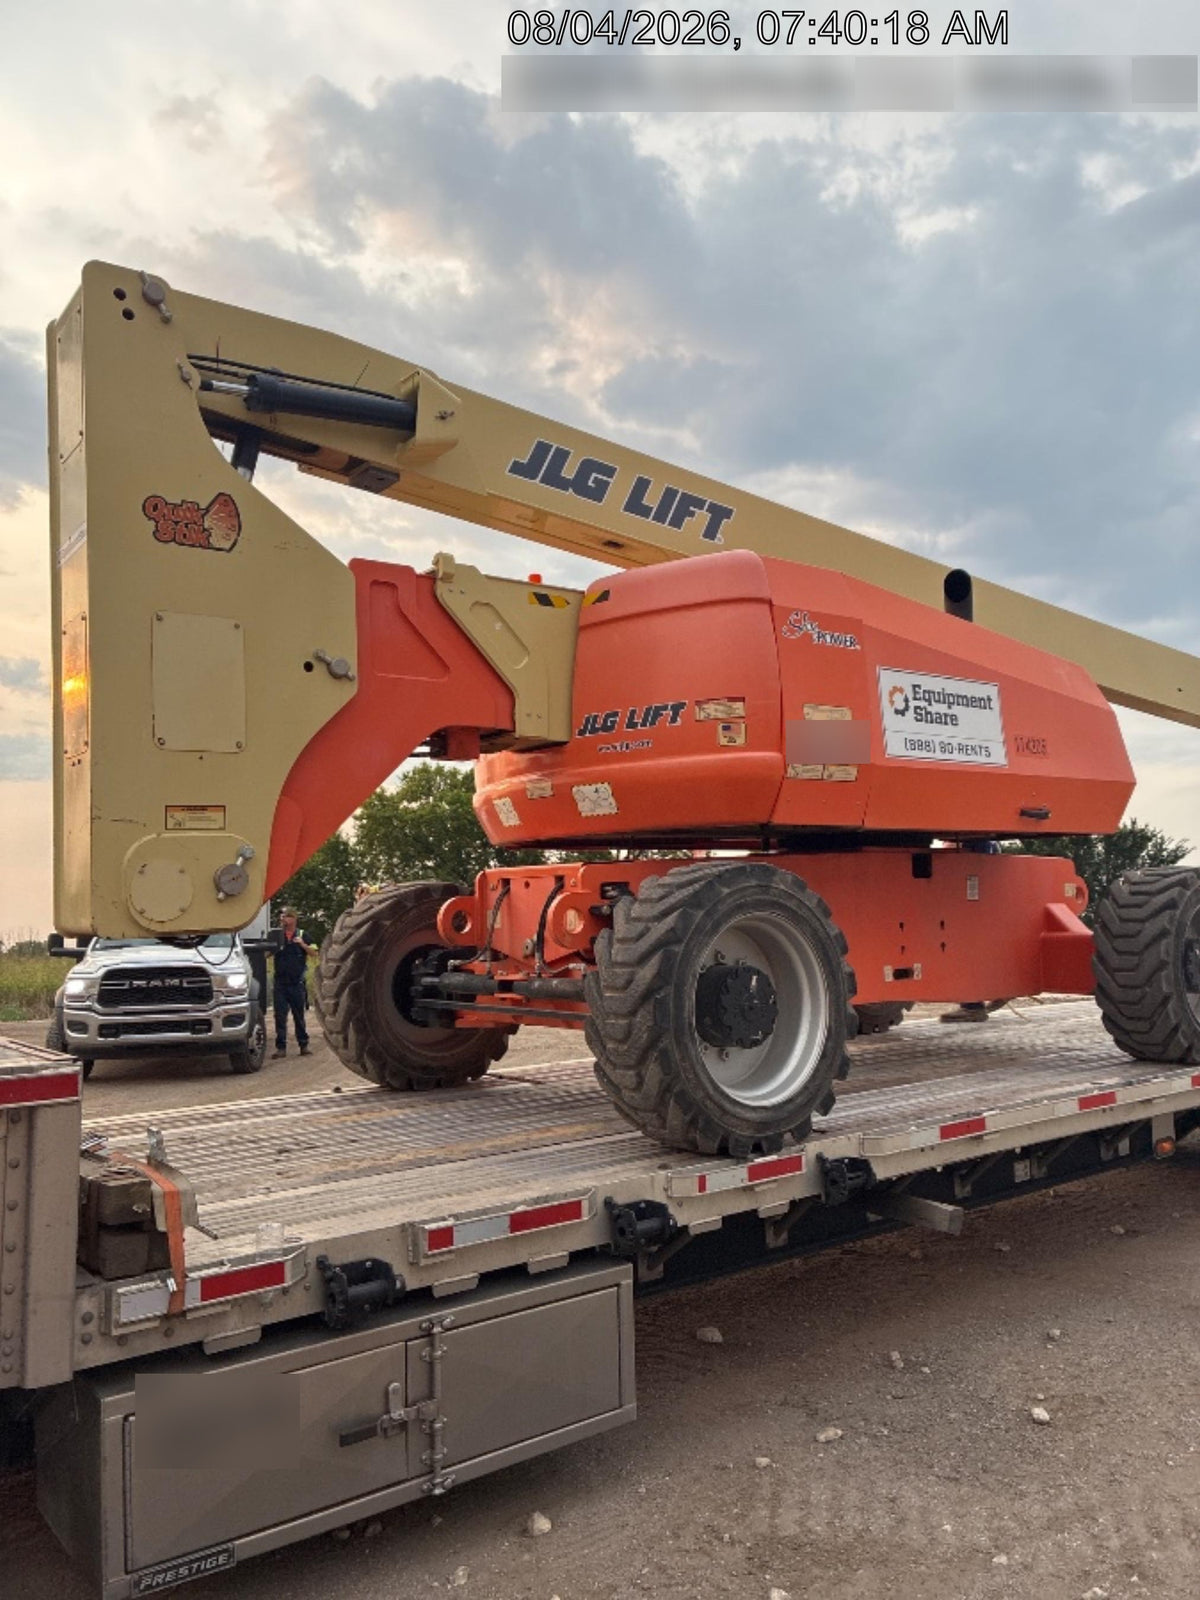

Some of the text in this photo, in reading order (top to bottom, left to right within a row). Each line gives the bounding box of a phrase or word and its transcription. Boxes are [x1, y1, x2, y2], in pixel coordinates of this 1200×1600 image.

[506, 439, 736, 544] JLG LIFT
[911, 684, 993, 710] Equipment
[576, 710, 620, 738] JLG
[625, 701, 688, 730] LIFT
[913, 705, 960, 726] Share
[904, 737, 937, 754] (888)
[140, 1553, 229, 1590] PRESTIGE
